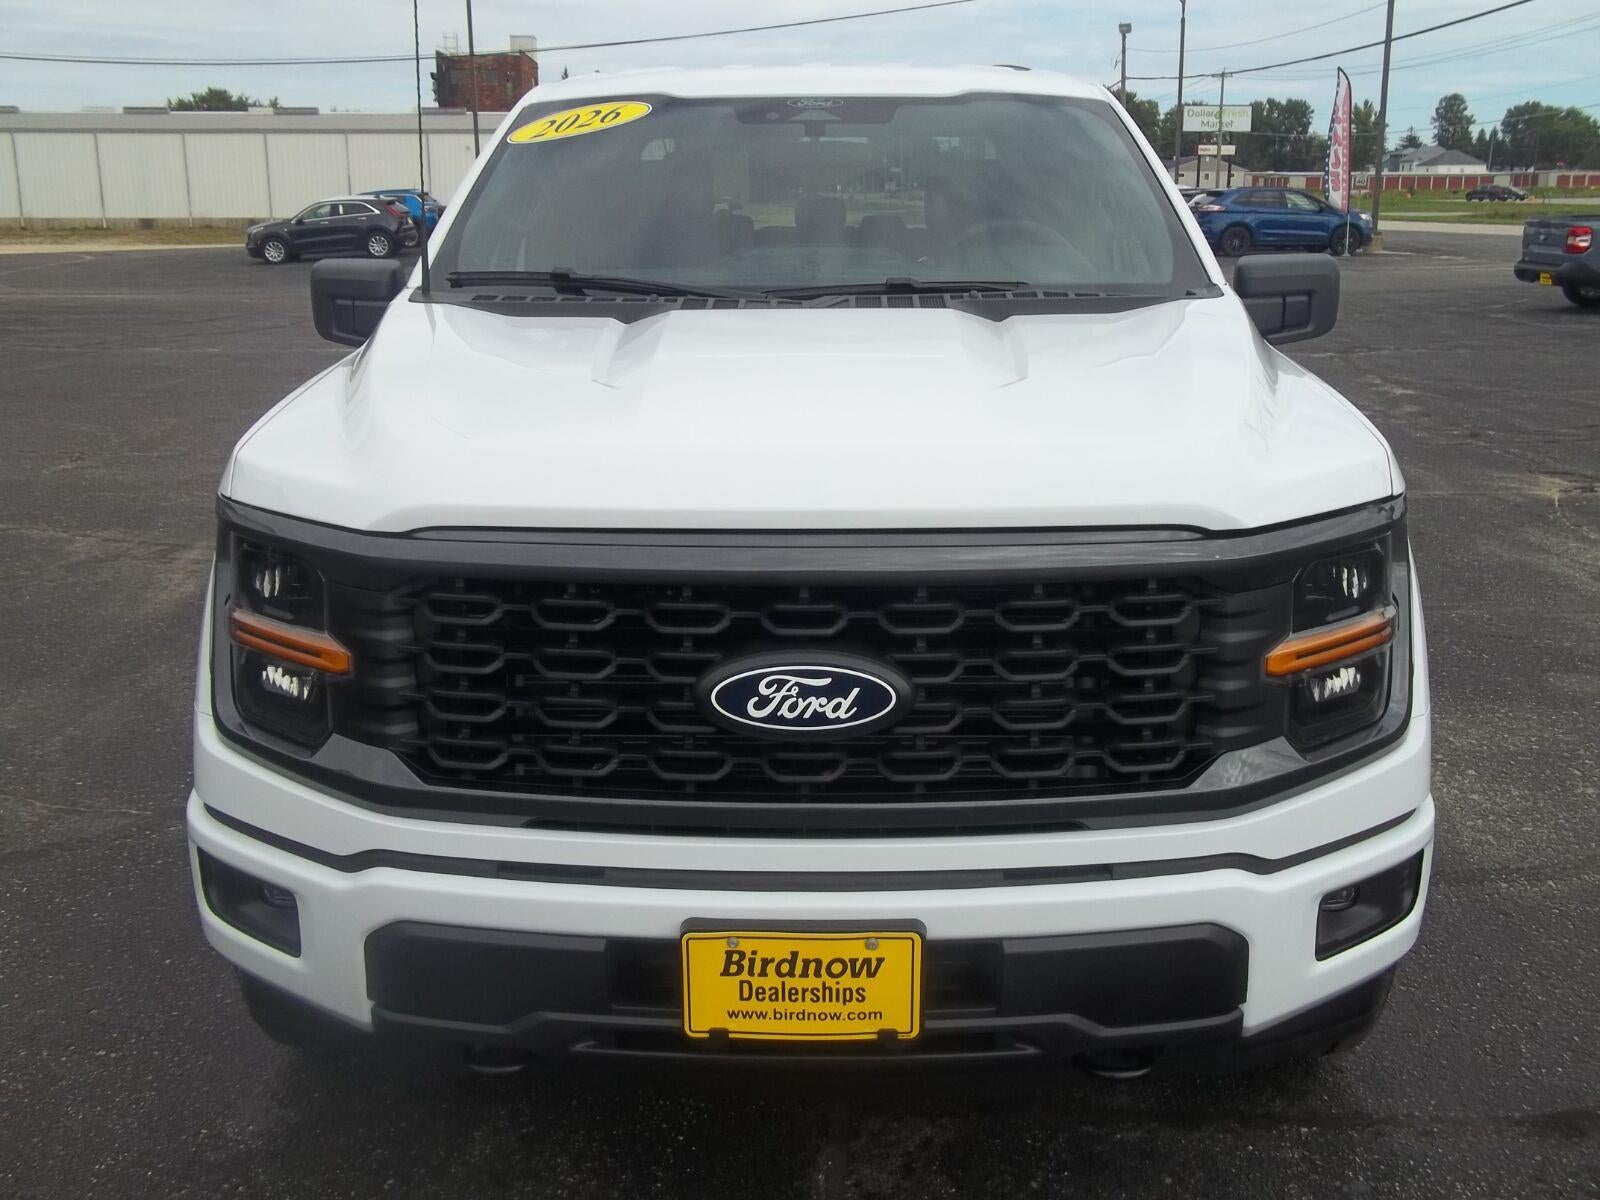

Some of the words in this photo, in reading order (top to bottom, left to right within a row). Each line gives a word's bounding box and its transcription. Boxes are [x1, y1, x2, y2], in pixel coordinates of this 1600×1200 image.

[529, 104, 628, 140] 2026
[1187, 109, 1213, 118] Dollar
[747, 674, 860, 719] Ford
[720, 950, 886, 979] Birdnow
[739, 979, 867, 1006] Dealerships
[727, 1008, 883, 1022] www.birdnow.com
